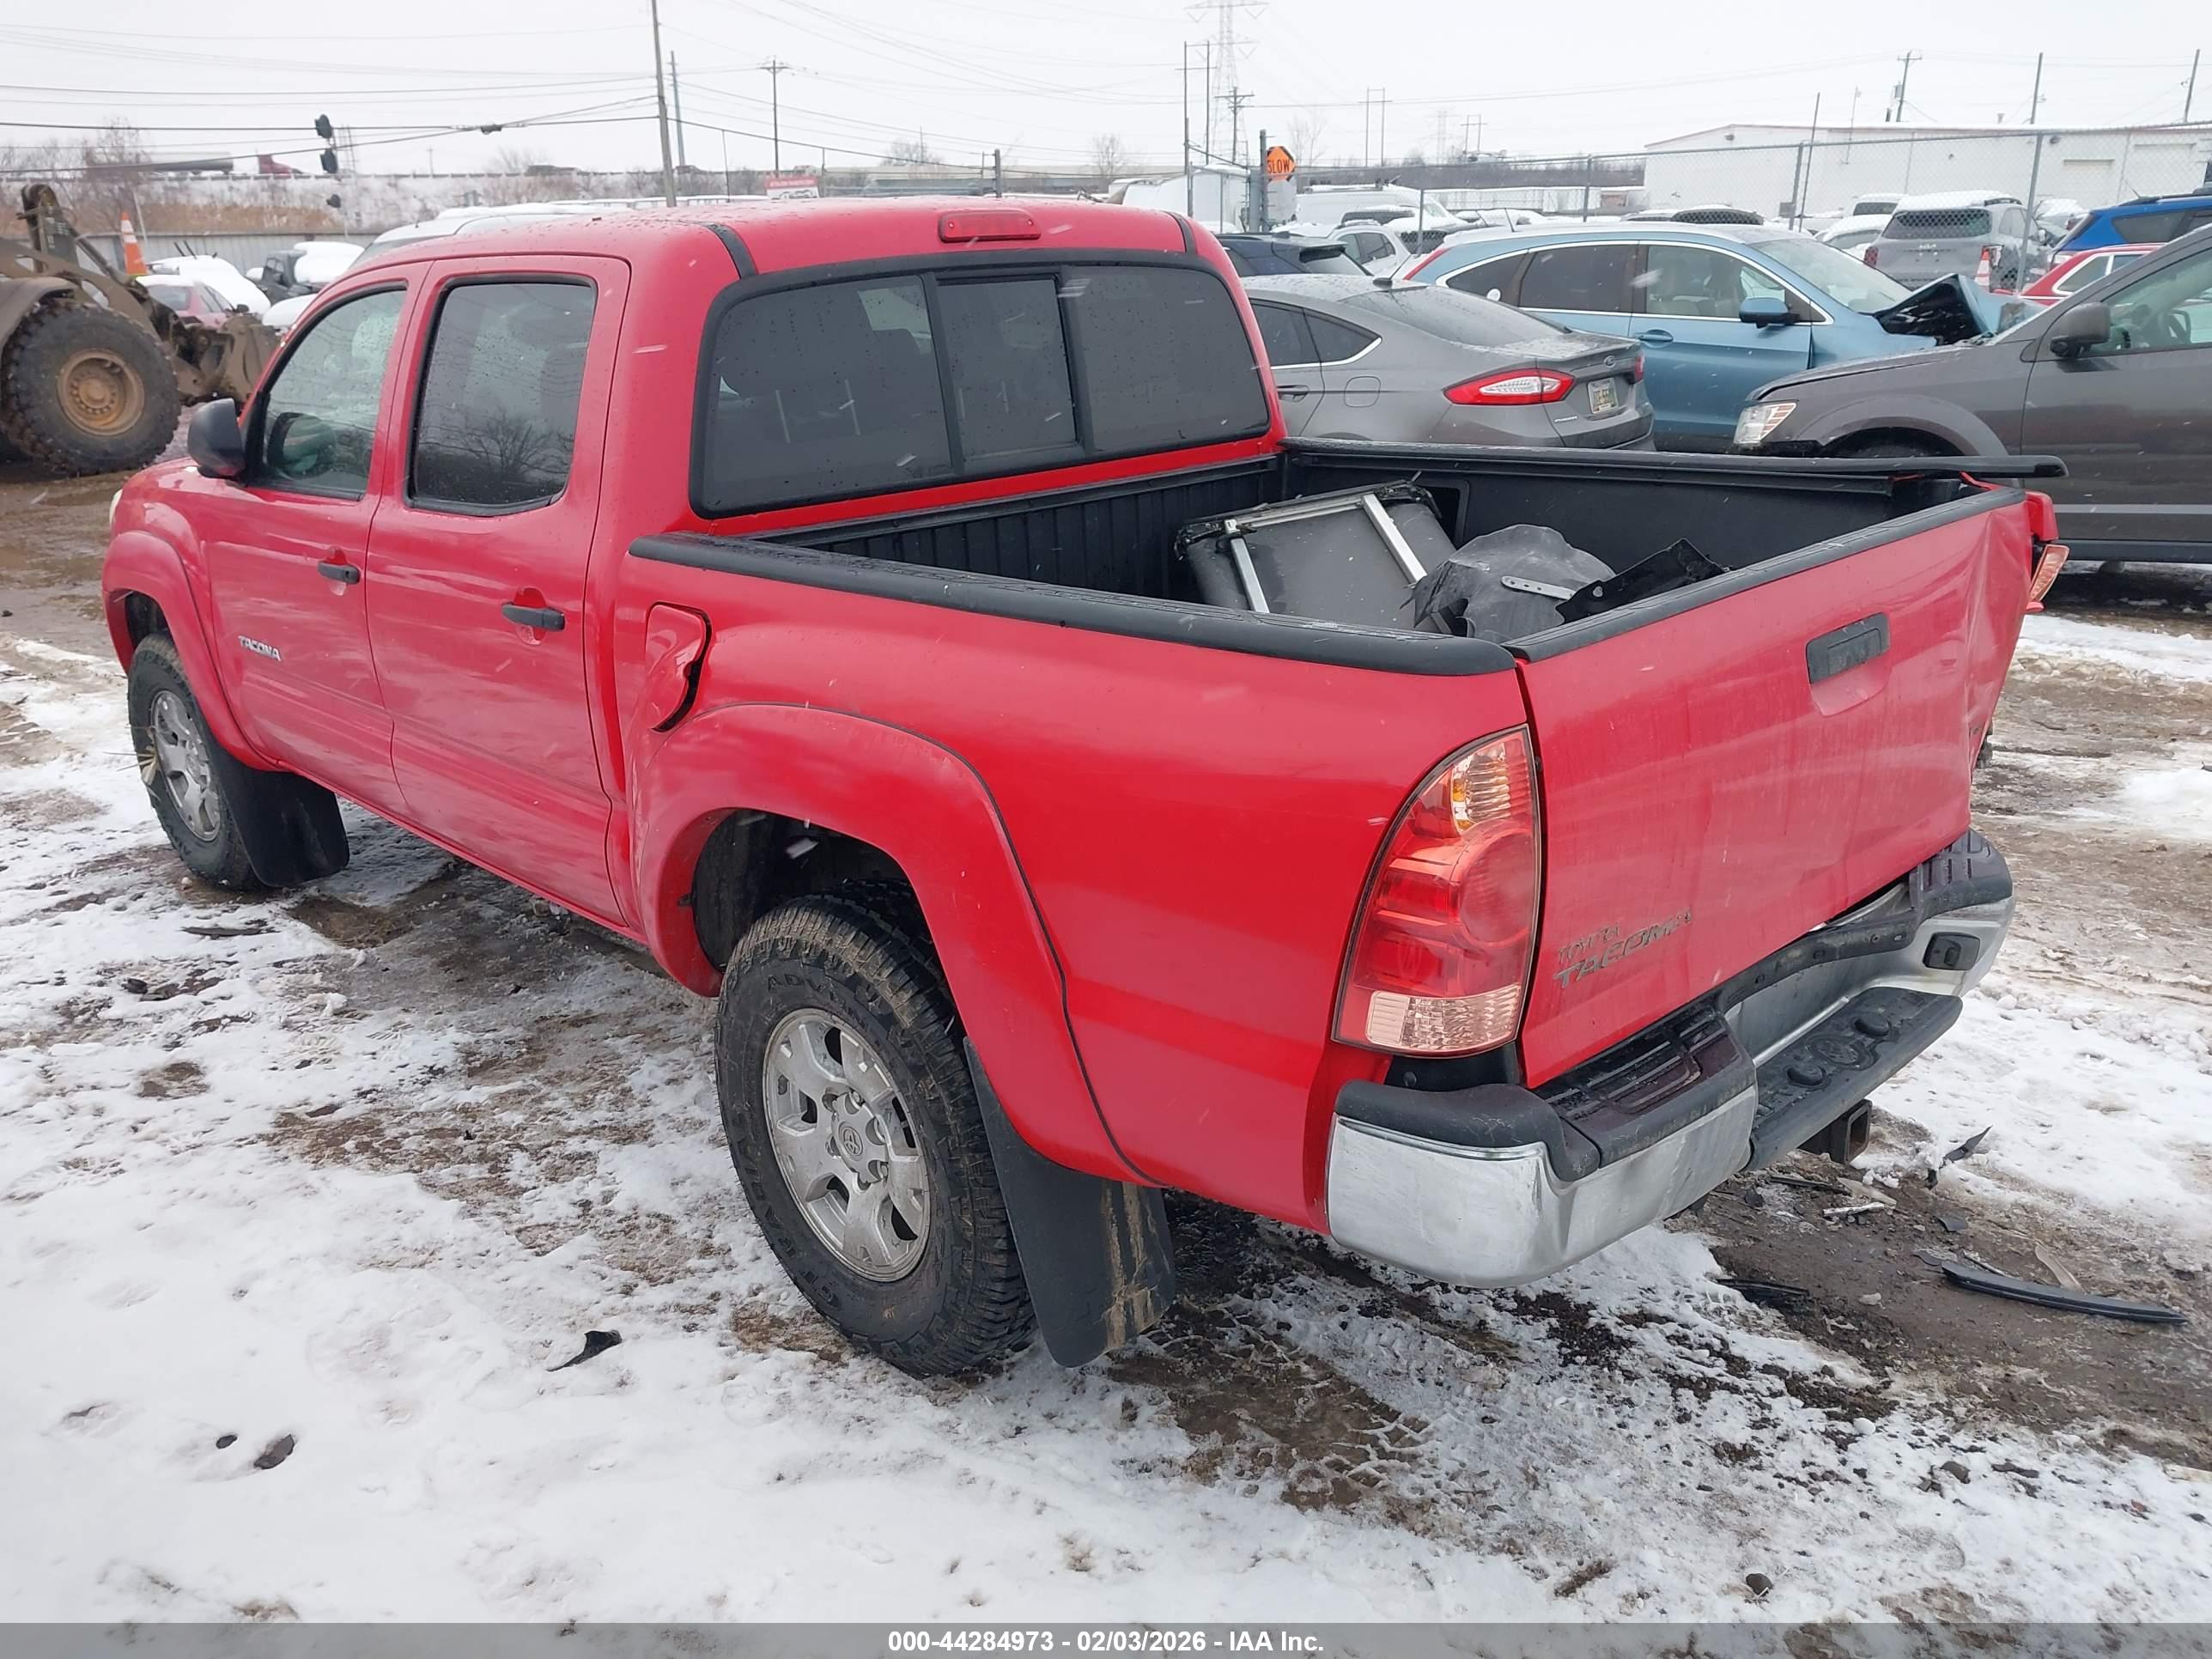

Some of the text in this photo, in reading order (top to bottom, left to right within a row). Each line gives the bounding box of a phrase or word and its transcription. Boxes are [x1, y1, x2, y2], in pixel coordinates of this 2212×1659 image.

[1267, 159, 1291, 173] SLOW
[238, 635, 282, 661] TACOMA
[1553, 907, 1692, 989] TACOMA
